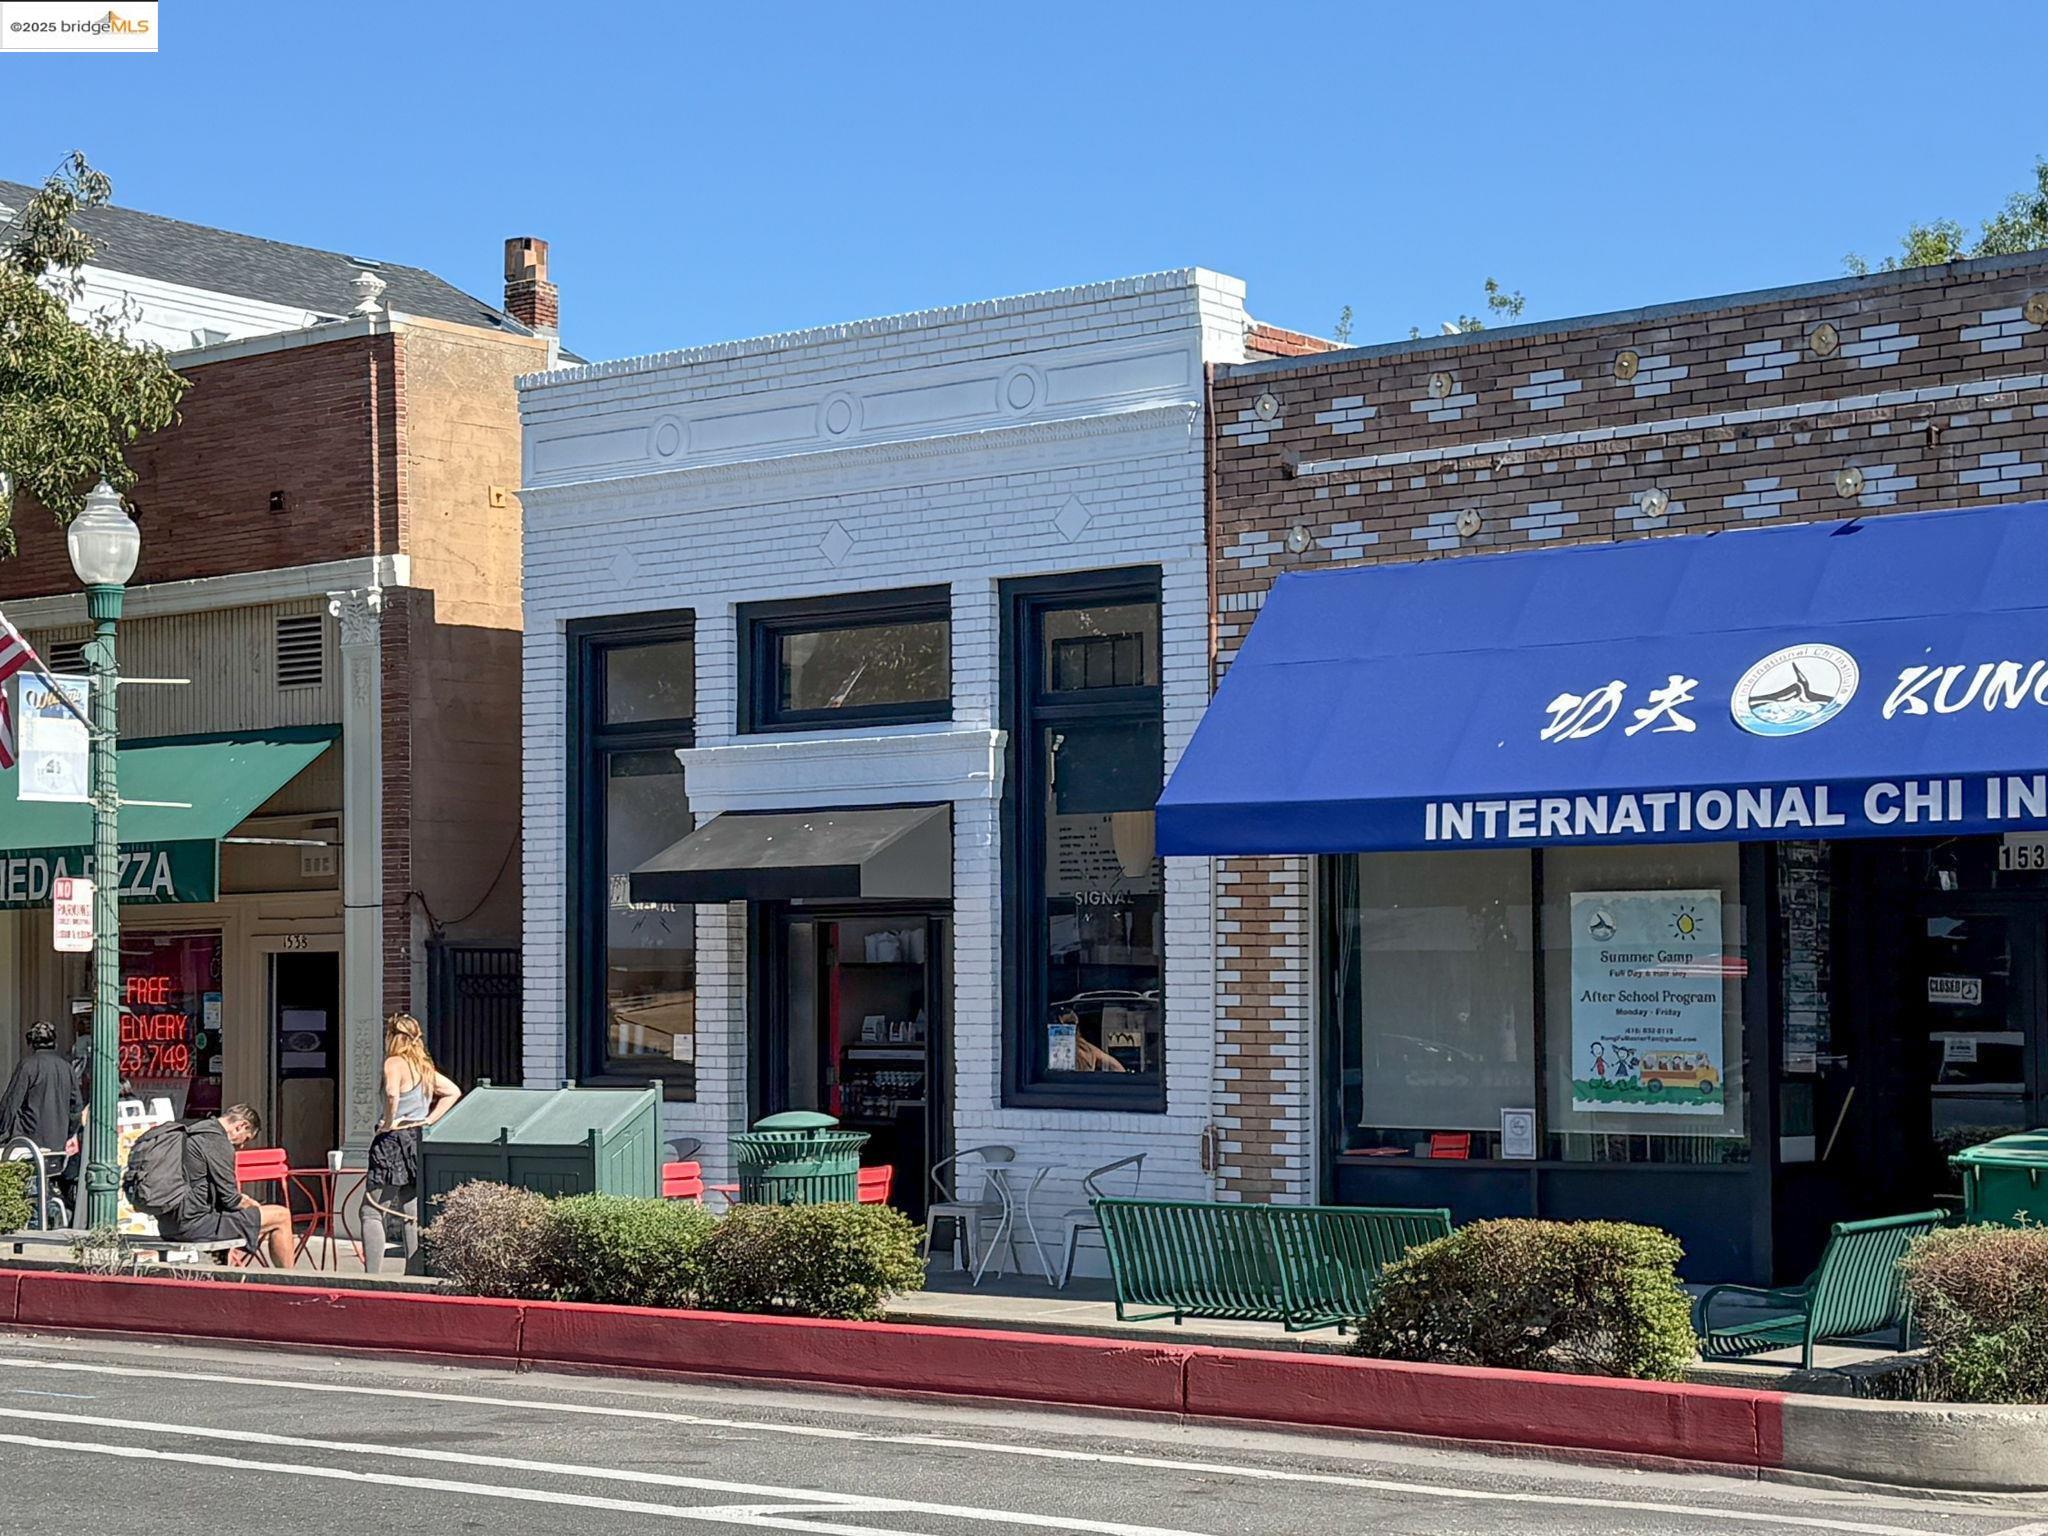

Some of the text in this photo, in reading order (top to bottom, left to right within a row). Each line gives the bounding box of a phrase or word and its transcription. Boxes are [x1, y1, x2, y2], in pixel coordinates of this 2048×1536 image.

[1424, 775, 2047, 836] INTERNATIONAL CHI IN
[2001, 845, 2046, 869] 153
[83, 851, 175, 897] ZZA
[56, 880, 72, 899] NO
[1074, 890, 1135, 906] SIGNAL
[1600, 950, 1655, 963] Summer
[126, 976, 170, 1005] FREE
[1930, 980, 1961, 994] CLOSED
[1580, 990, 1717, 1005] After School Program
[1616, 1008, 1648, 1017] Monday
[1656, 1008, 1681, 1017] Friday
[119, 1014, 188, 1042] ELIVERY
